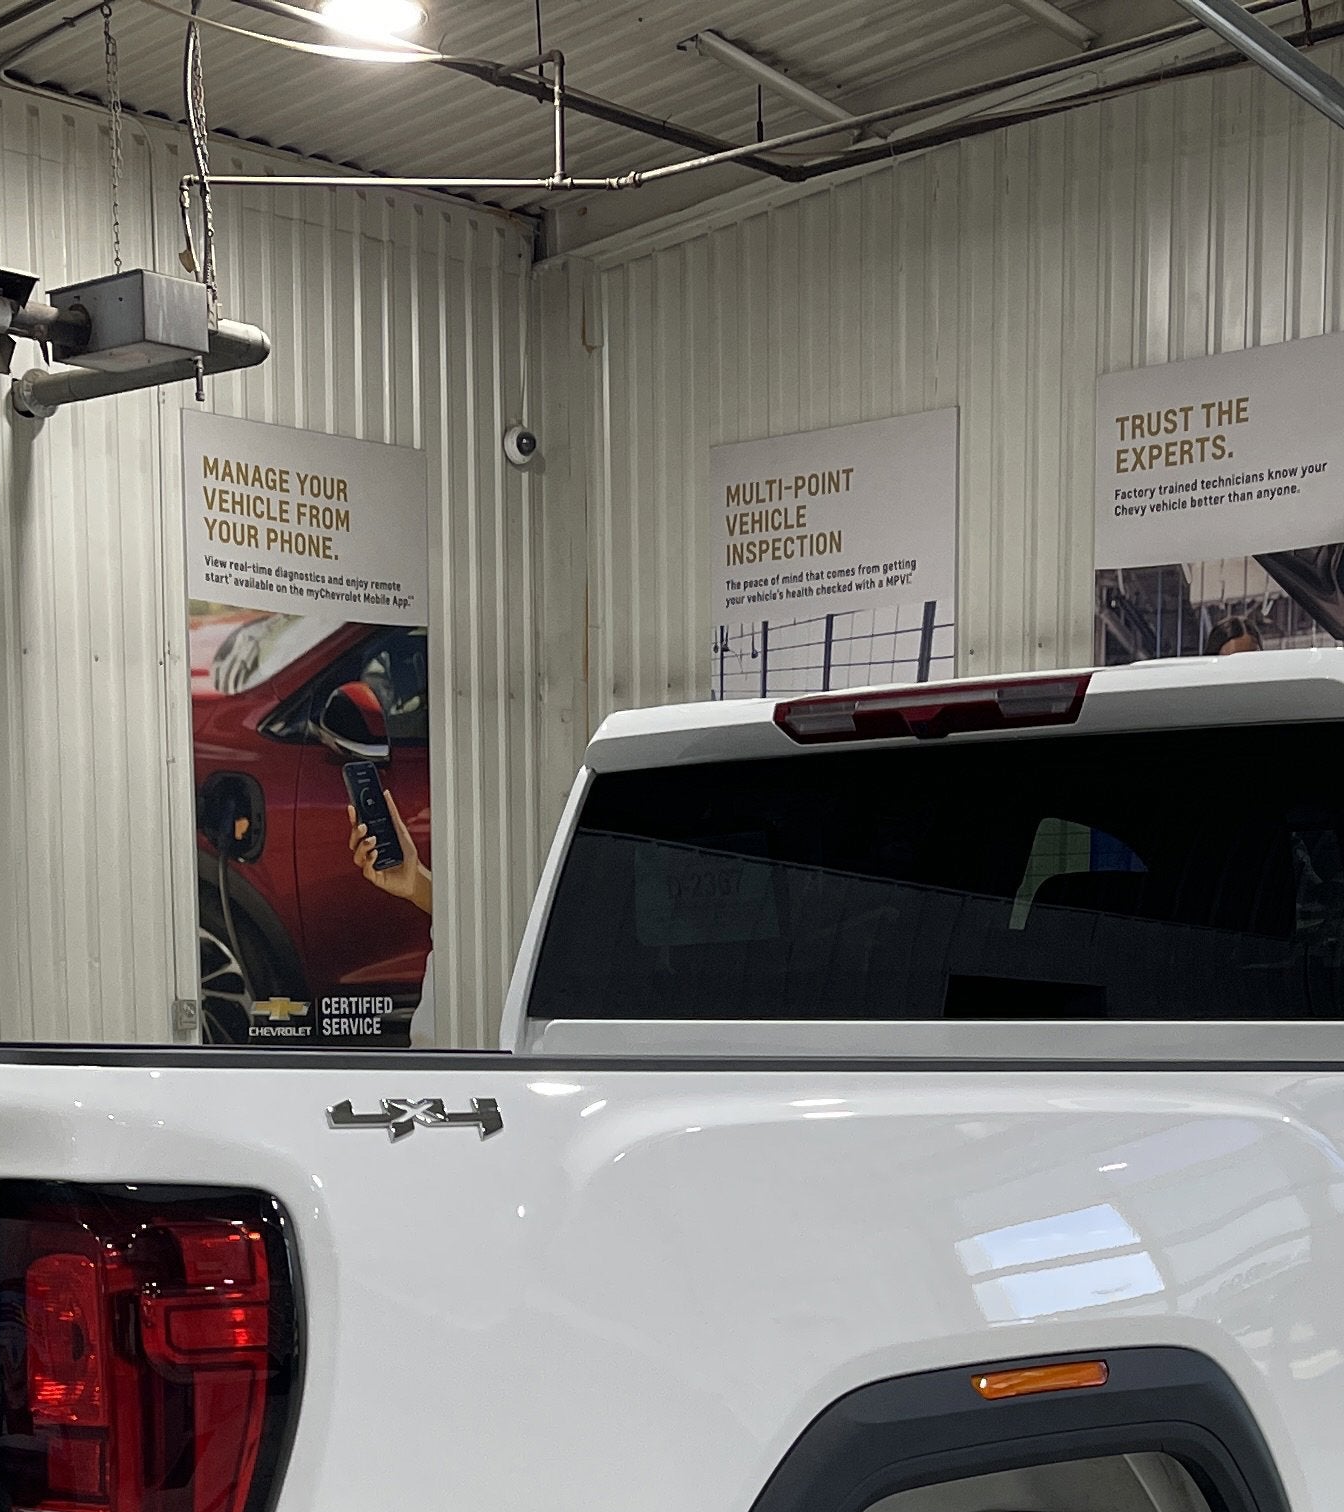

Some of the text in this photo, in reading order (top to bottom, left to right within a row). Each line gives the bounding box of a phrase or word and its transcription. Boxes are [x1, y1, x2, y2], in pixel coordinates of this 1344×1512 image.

[1115, 396, 1250, 441] TRUST THE
[1116, 434, 1234, 474] EXPERTS.
[202, 455, 348, 503] MANAGE YOUR
[726, 467, 854, 508] MULTI-POINT
[1114, 461, 1328, 501] Factory trained technicians know your
[202, 486, 351, 533] VEHICLE FROM
[1114, 484, 1301, 518] Chevy vehicle better than anyone.
[203, 517, 339, 561] YOUR PHONE.
[725, 505, 807, 537] VEHICLE
[726, 530, 842, 567] INSPECTION
[204, 554, 401, 592] View real-time diagnostics and enjoy remote
[233, 577, 274, 592] available
[276, 584, 288, 594] on
[289, 584, 304, 596] the
[306, 588, 362, 604] myChevrolet
[363, 591, 391, 605] Mobile
[726, 558, 916, 591] The peace of mind that comes from getting
[725, 595, 745, 608] your
[746, 589, 784, 604] vehicle's
[786, 585, 814, 599] health
[816, 582, 853, 596] checked
[855, 578, 876, 591] with
[877, 579, 884, 589] a
[321, 996, 393, 1015] CERTIFIED
[248, 1026, 313, 1037] CHEVROLET
[321, 1017, 382, 1036] SERVICE
